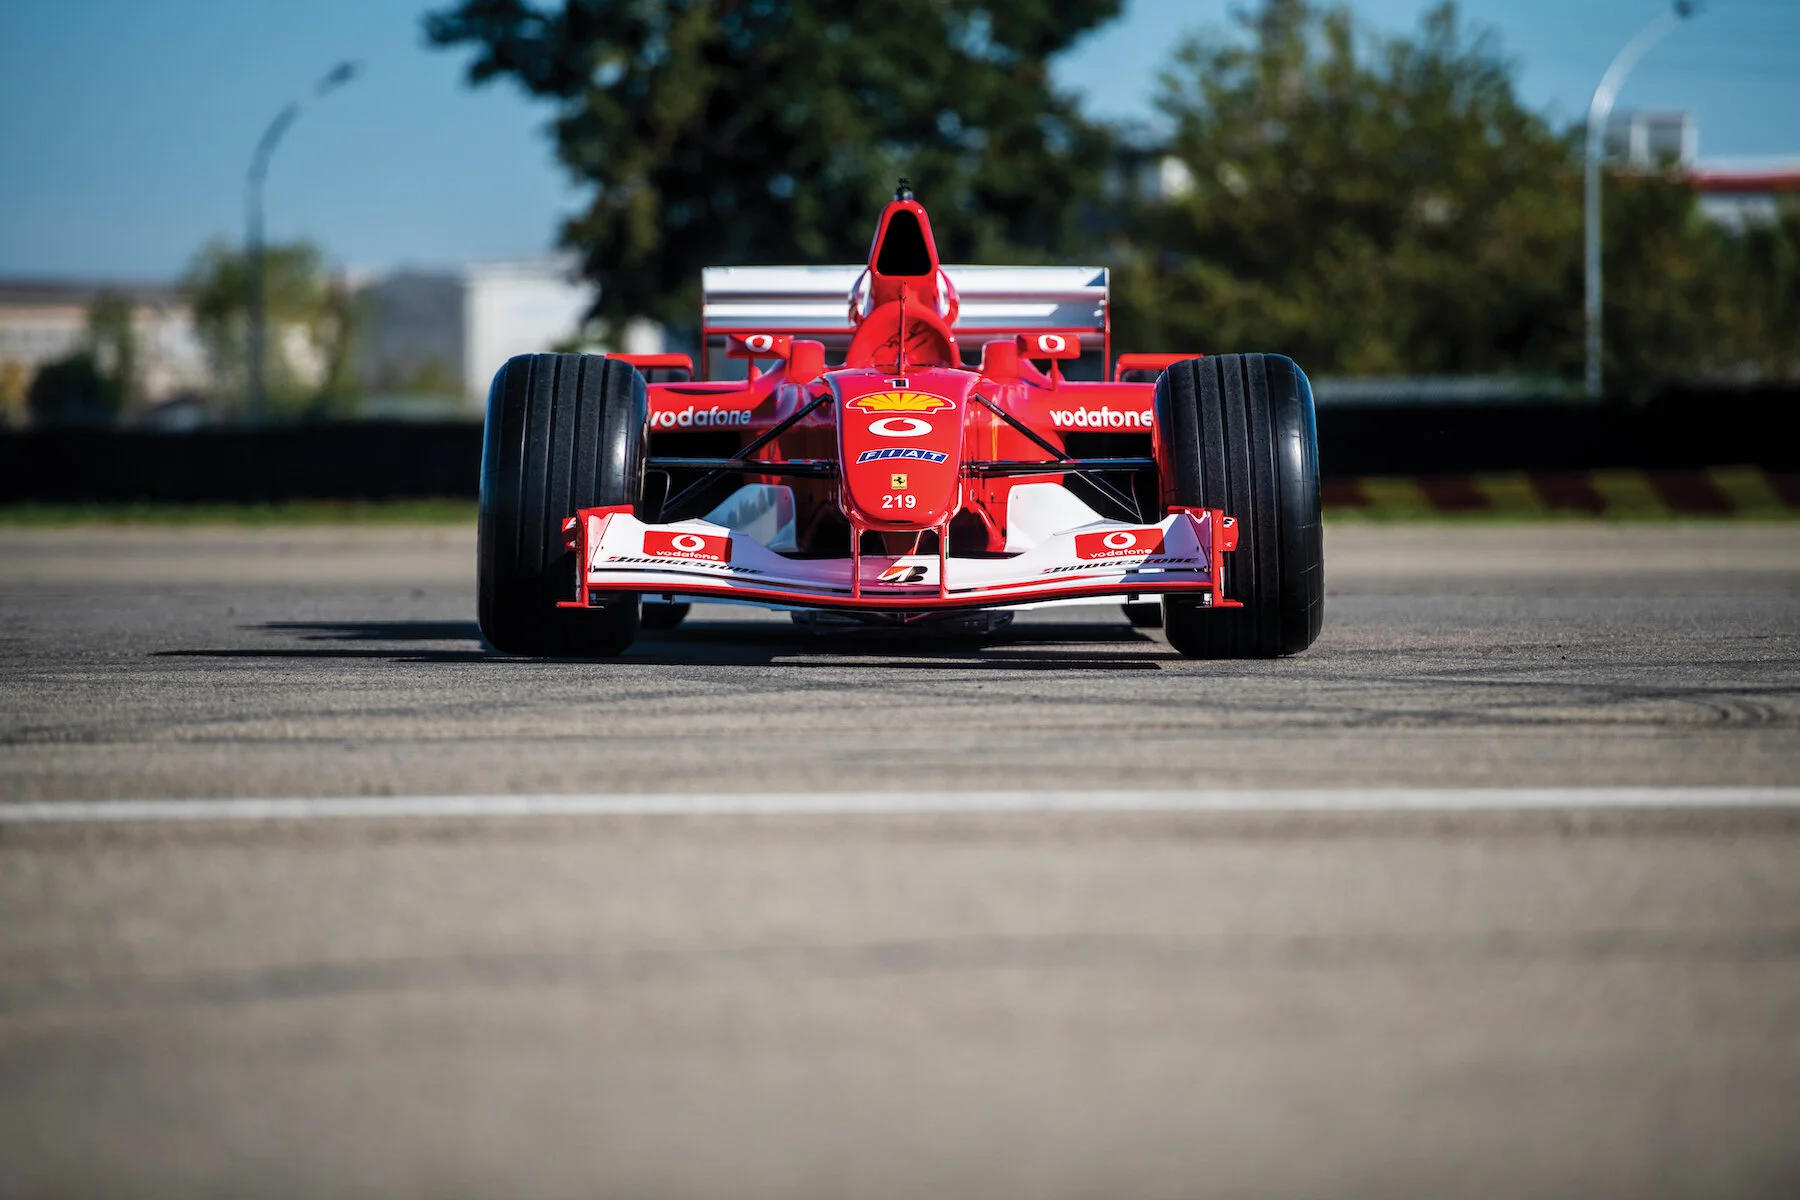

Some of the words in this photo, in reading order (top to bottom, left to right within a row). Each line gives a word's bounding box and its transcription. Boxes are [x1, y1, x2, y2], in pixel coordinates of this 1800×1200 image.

[1049, 406, 1153, 427] vodafone
[863, 449, 944, 461] FIAT
[882, 495, 917, 509] 219
[656, 550, 719, 561] vodafone
[1090, 548, 1153, 559] vodafone
[606, 556, 764, 575] BRIDGESTONE
[1041, 557, 1199, 575] BRIDGESTONE
